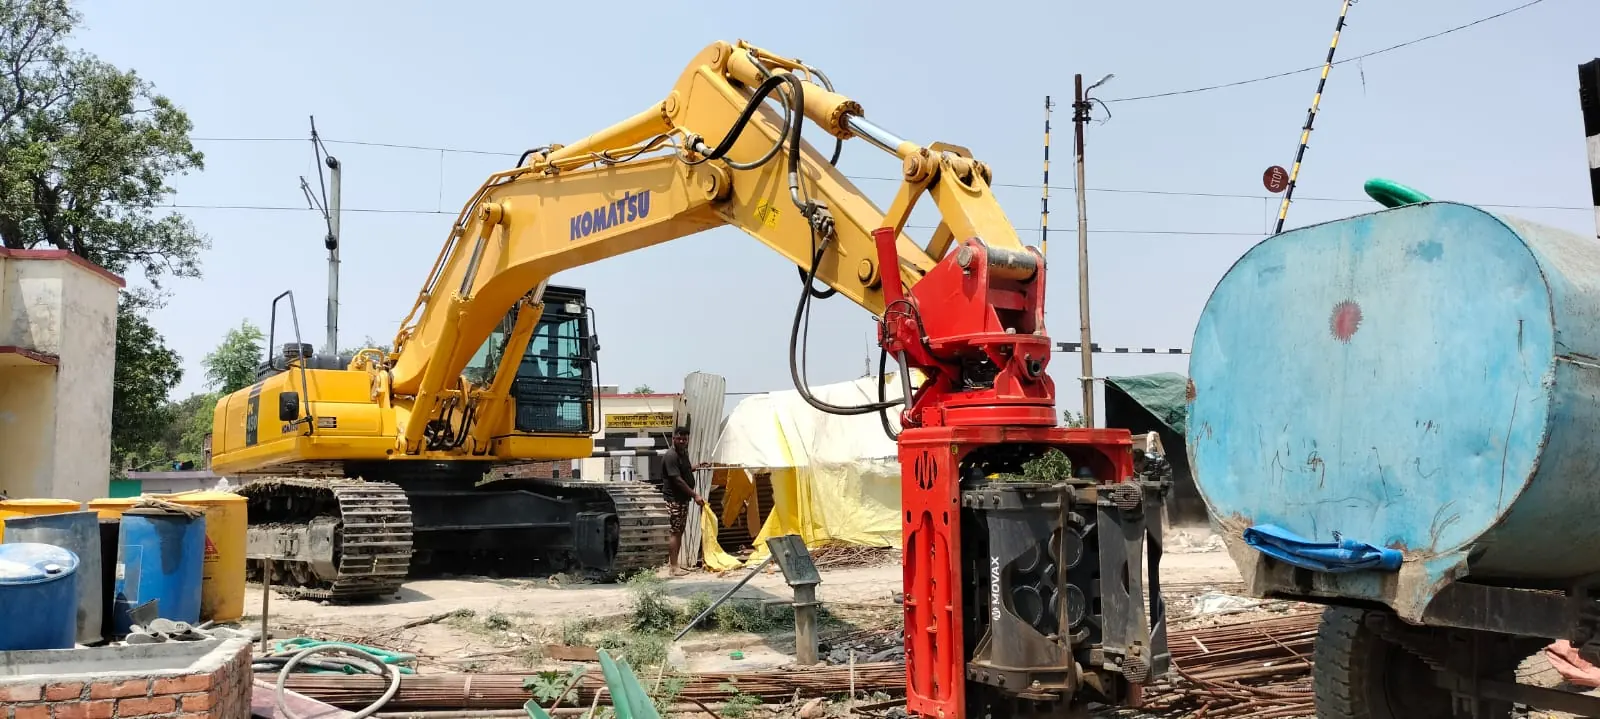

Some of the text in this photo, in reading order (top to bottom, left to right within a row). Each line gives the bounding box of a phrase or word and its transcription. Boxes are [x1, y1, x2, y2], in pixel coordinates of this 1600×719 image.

[1270, 167, 1283, 189] STOP
[570, 189, 650, 241] KOMATSU
[991, 556, 1000, 605] MOVAX
